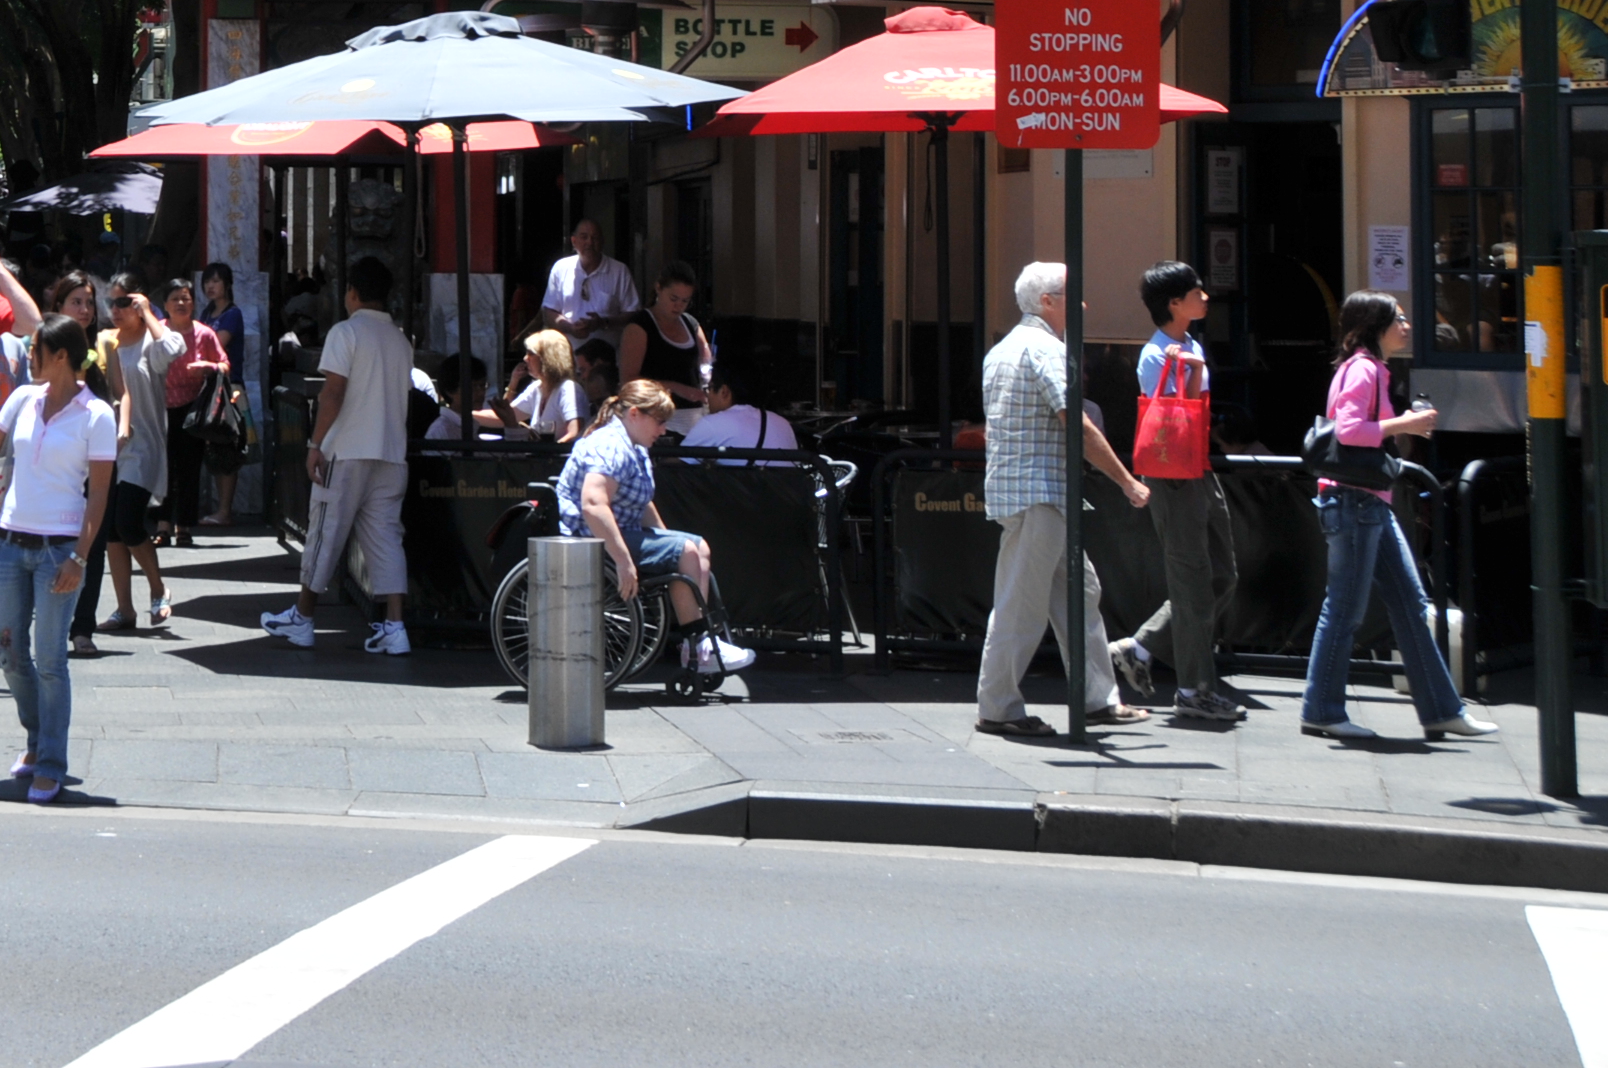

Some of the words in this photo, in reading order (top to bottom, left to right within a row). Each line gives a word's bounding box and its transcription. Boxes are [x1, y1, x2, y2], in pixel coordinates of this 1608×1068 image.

[1065, 8, 1092, 26] NO
[1029, 33, 1123, 52] STOPPING
[883, 67, 996, 84] CARLTO
[1008, 88, 1144, 107] 6.00PM-6.00AM
[1032, 112, 1120, 130] MON-SUN
[457, 479, 496, 498] Garden
[497, 479, 527, 498] Hotel
[915, 492, 962, 512] Covent
